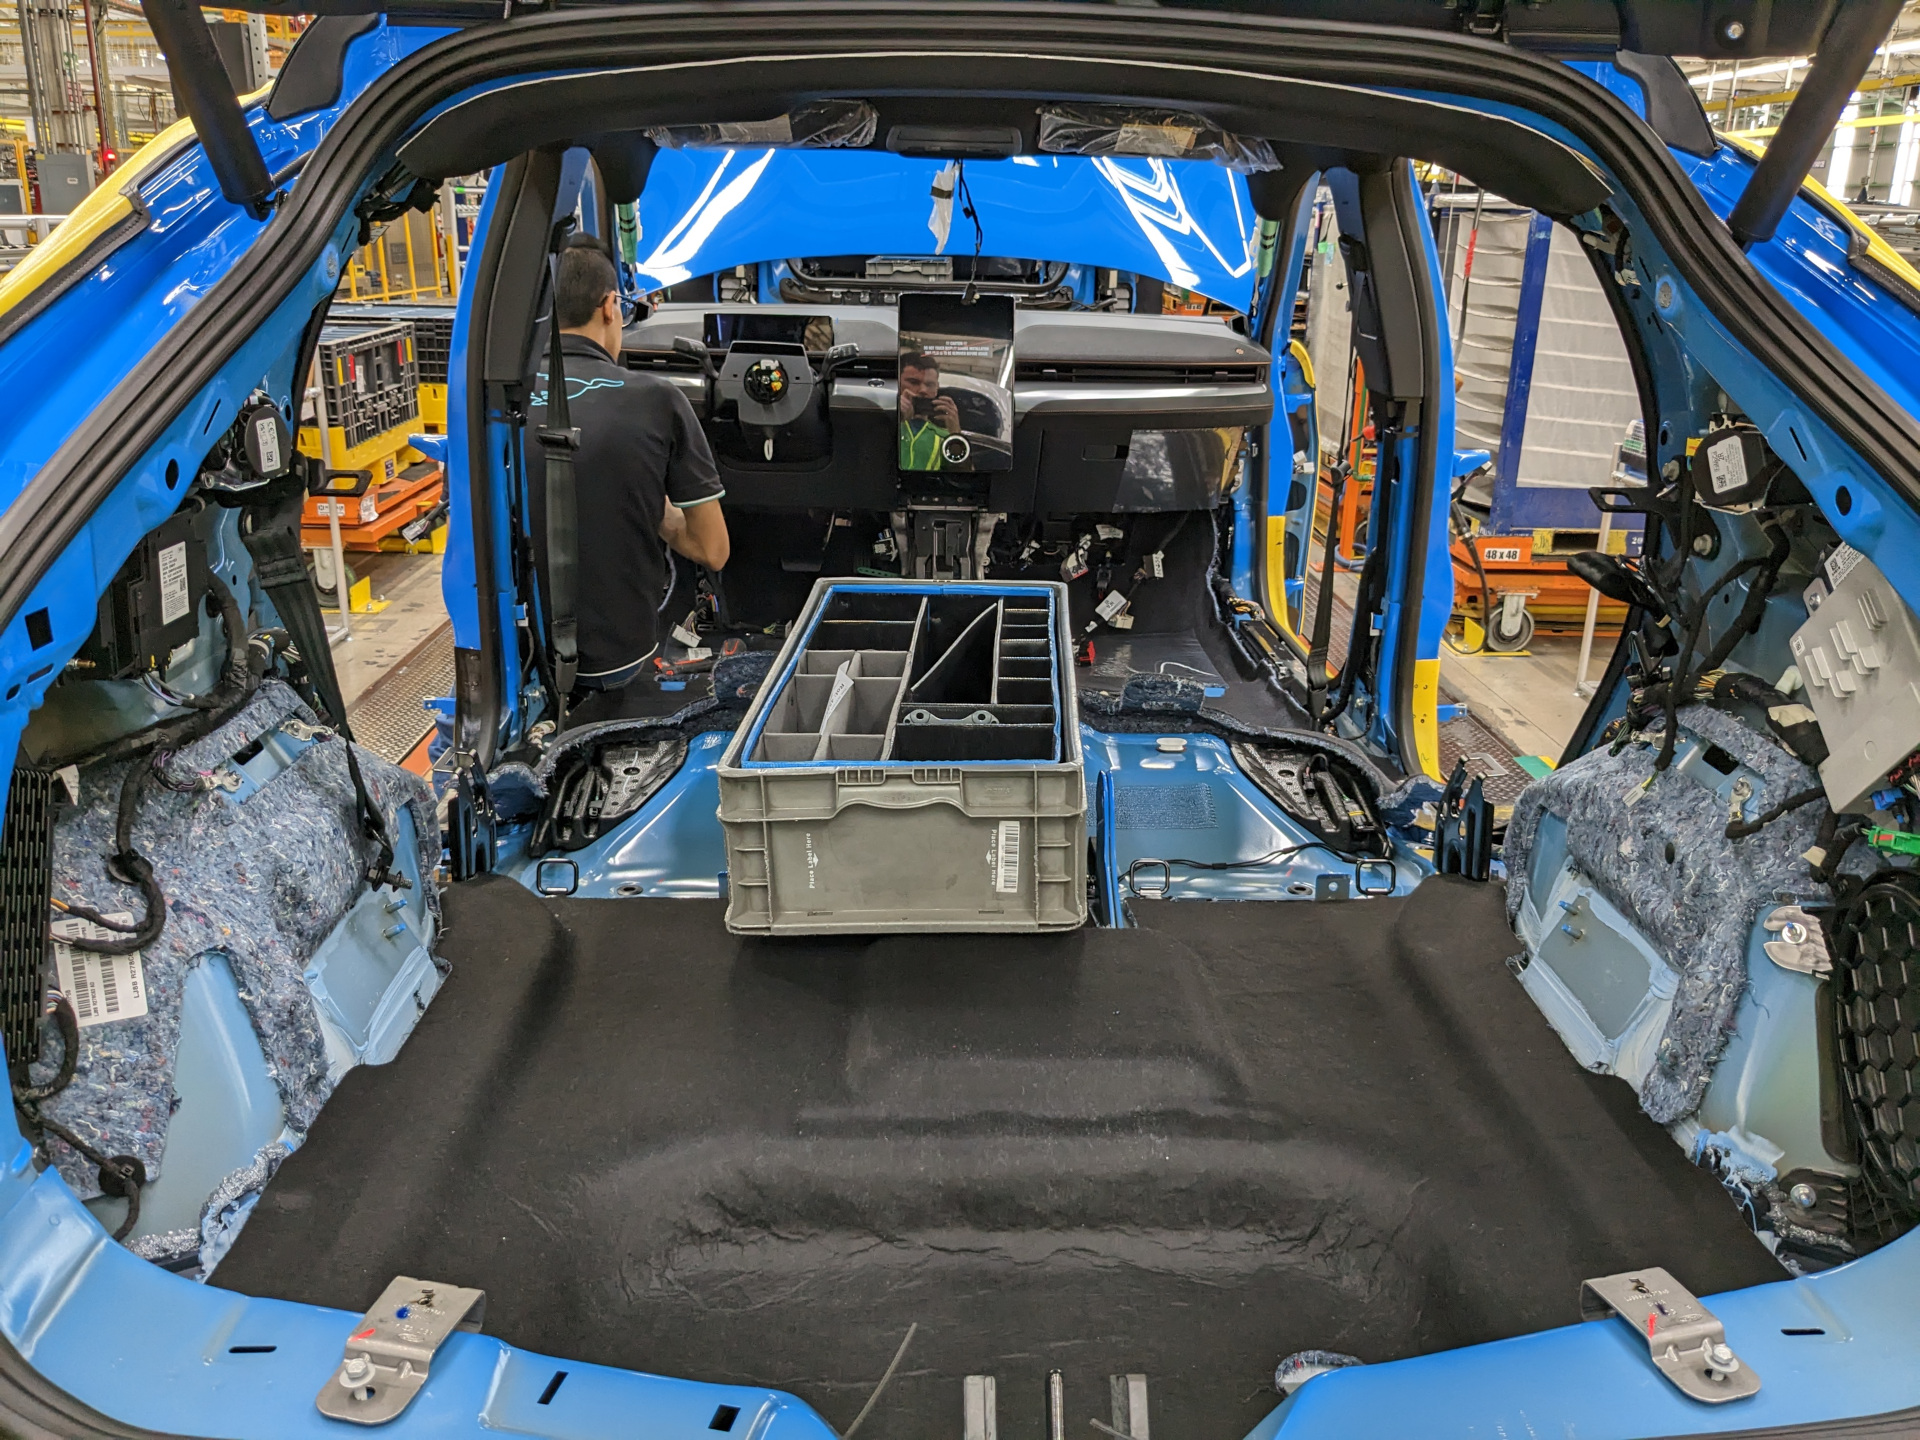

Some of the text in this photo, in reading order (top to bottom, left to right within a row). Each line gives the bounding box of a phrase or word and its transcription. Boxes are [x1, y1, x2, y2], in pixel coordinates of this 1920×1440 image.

[1485, 549, 1498, 560] 48
[1506, 549, 1518, 560] 48
[806, 850, 814, 869] Label
[132, 980, 140, 999] LJ8B
